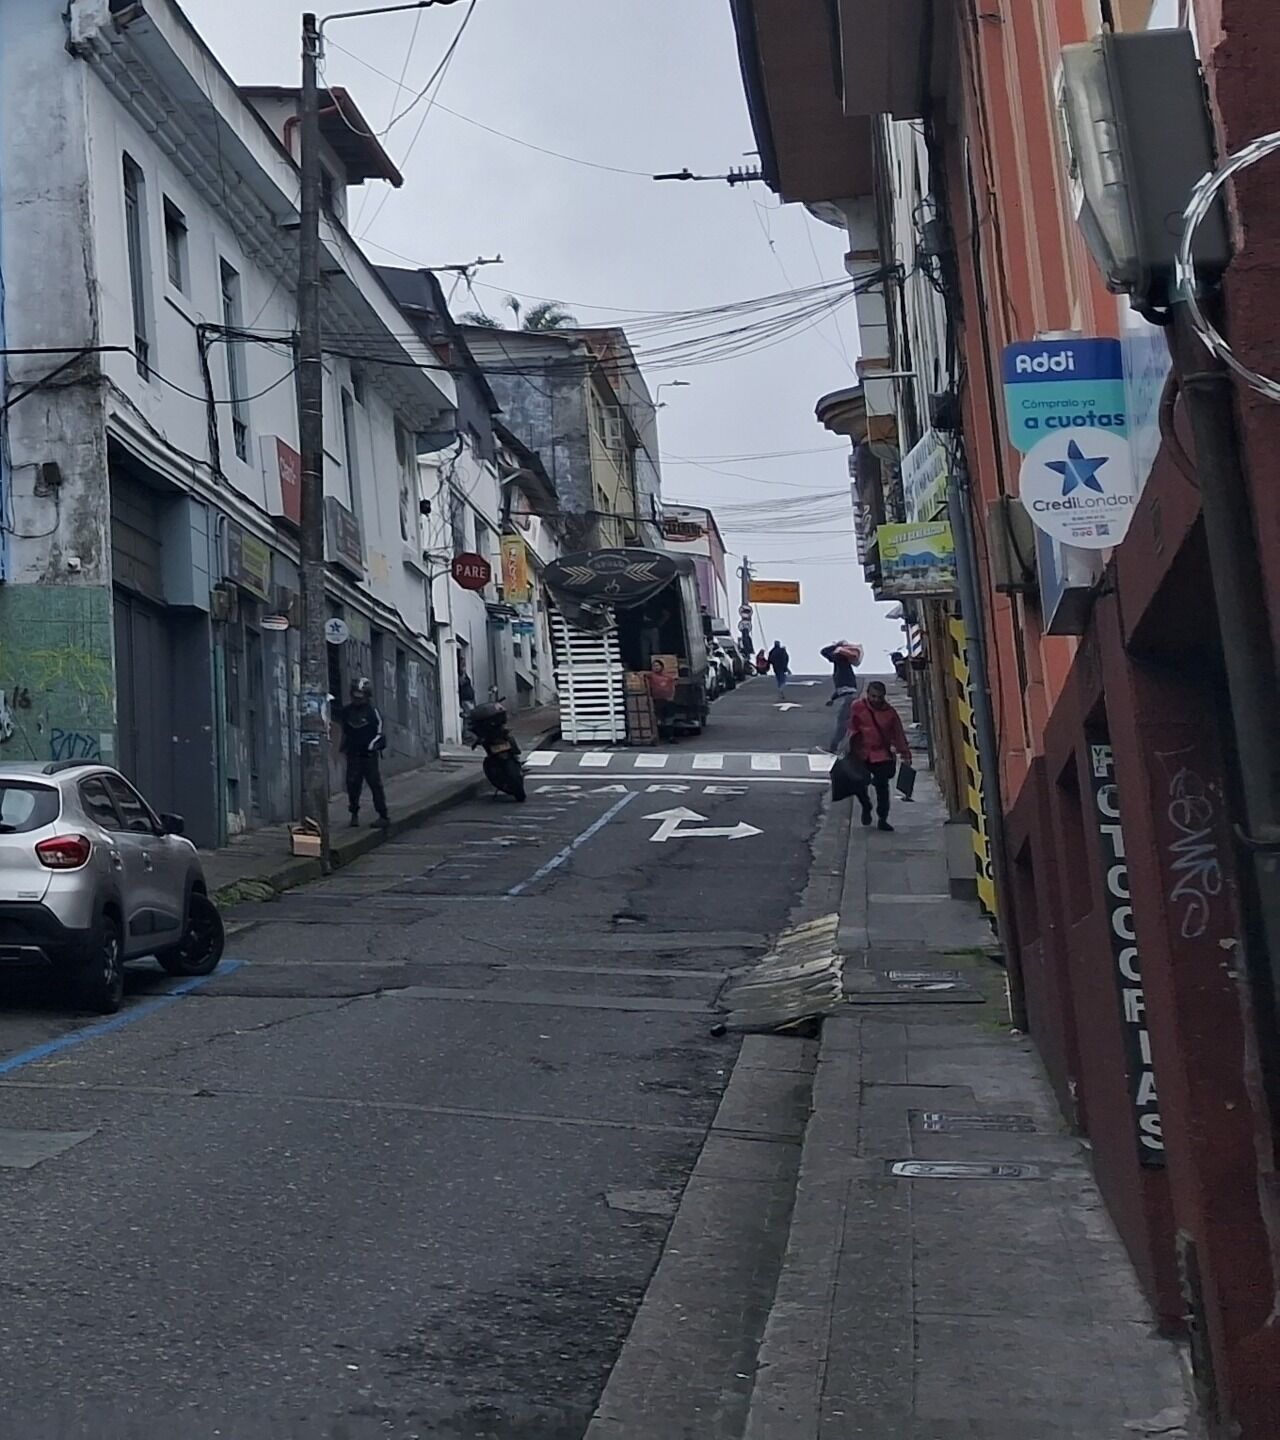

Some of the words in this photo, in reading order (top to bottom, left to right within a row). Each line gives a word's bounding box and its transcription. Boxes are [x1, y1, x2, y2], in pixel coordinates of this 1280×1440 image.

[1016, 351, 1074, 373] Addi
[1081, 399, 1096, 410] ya
[1024, 417, 1039, 429] a
[1044, 411, 1126, 429] cuotas
[456, 564, 486, 579] PARE
[533, 783, 751, 795] PARE
